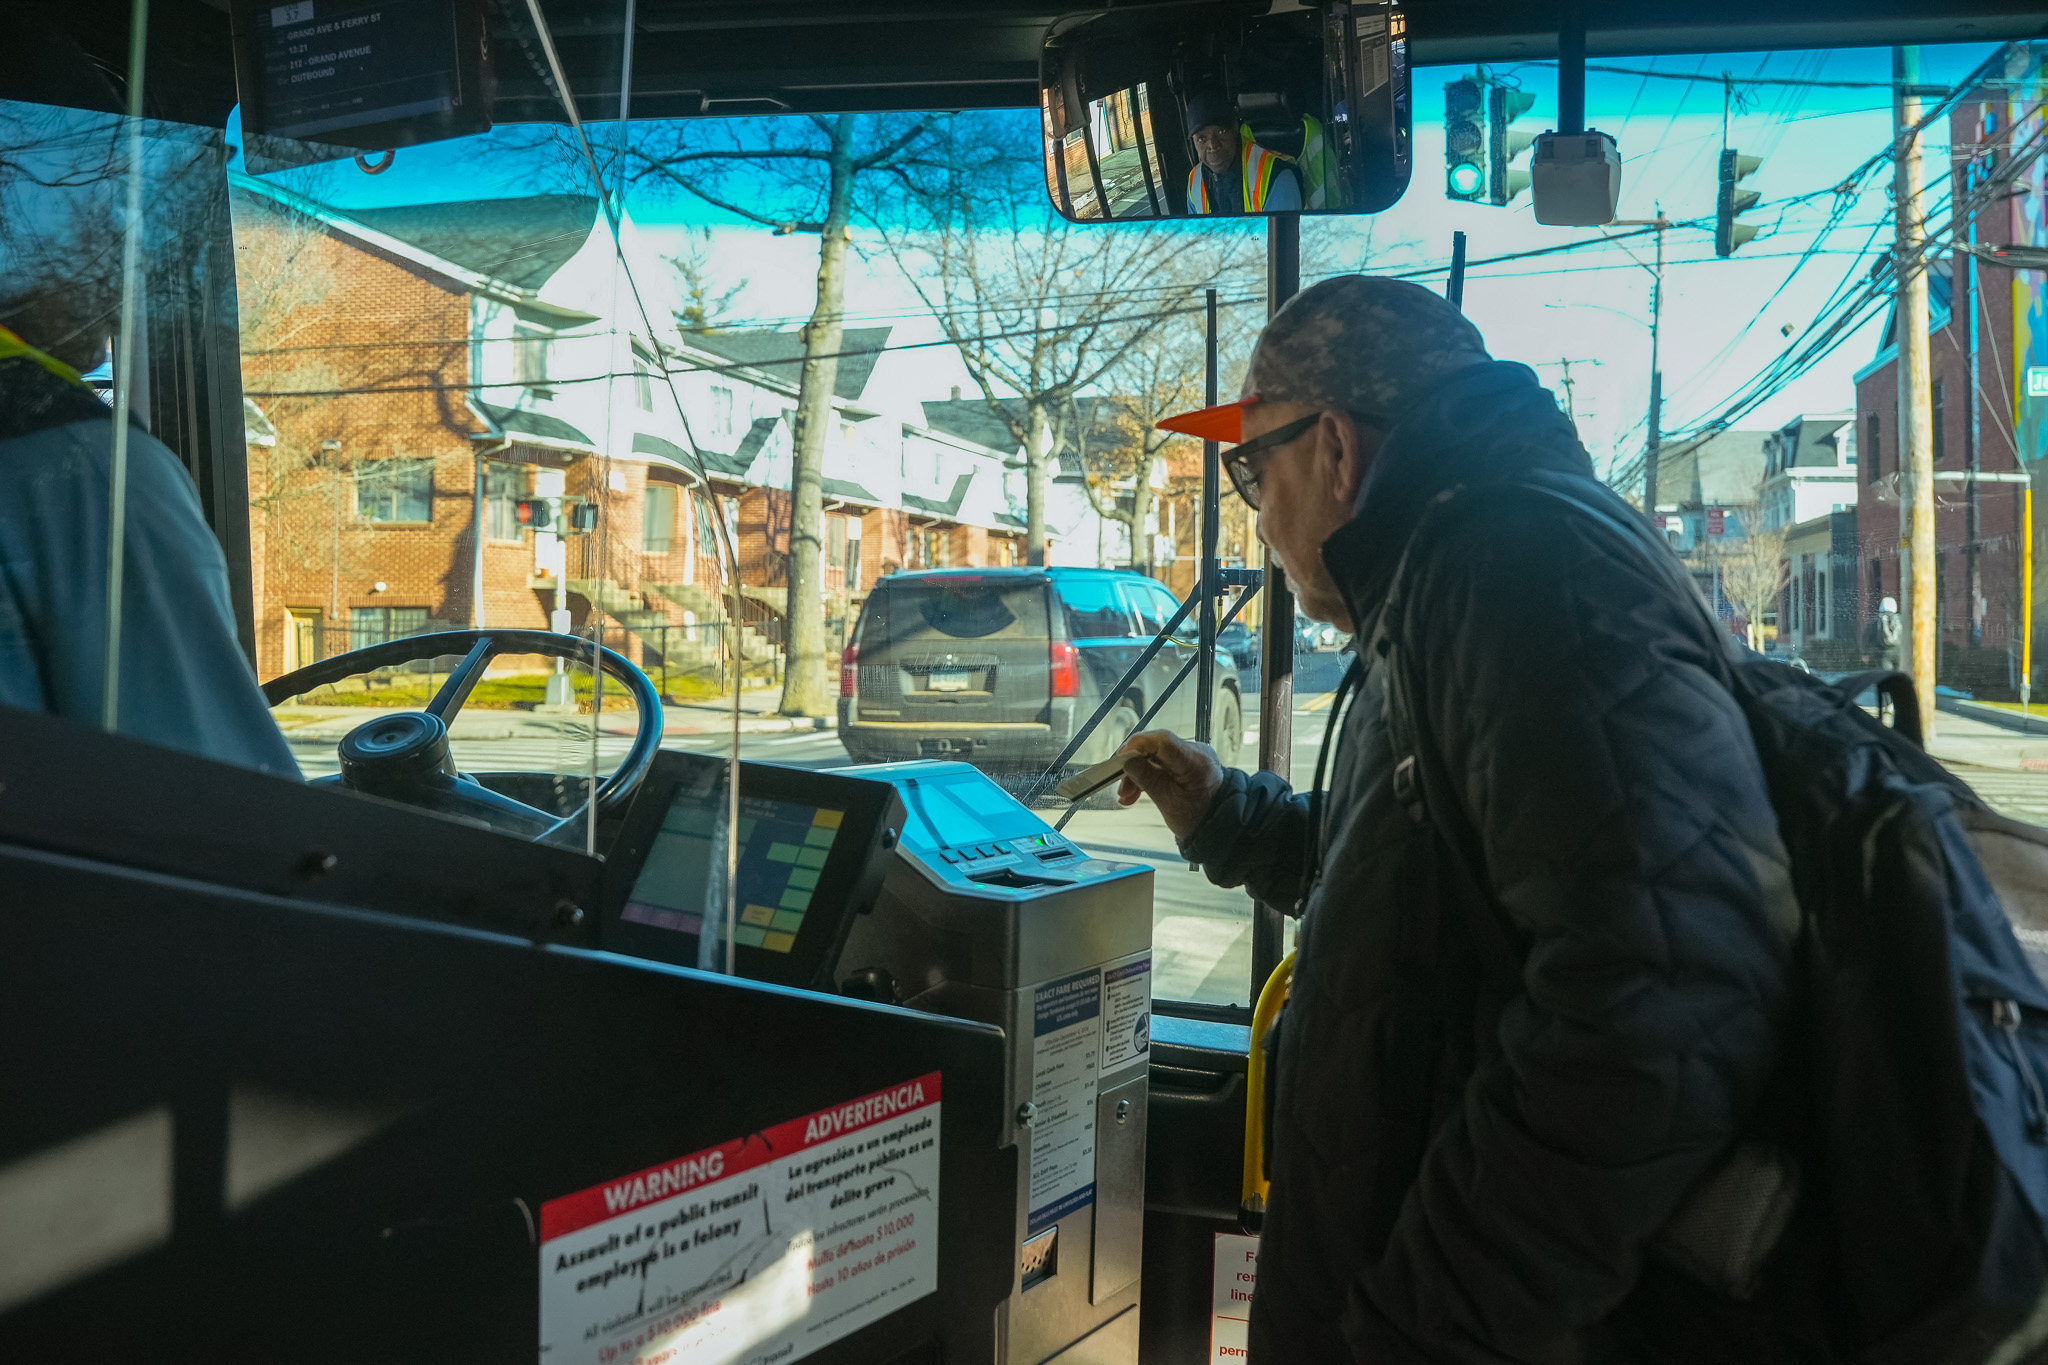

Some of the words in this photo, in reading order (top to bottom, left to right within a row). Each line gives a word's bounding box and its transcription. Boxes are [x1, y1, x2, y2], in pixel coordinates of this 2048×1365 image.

[287, 27, 315, 41] GRAND
[316, 23, 333, 34] AVE
[342, 16, 369, 29] FERRY
[370, 12, 381, 23] ST
[290, 59, 303, 70] 212
[308, 53, 336, 66] GRAND
[338, 46, 372, 60] AVENUE
[290, 67, 336, 83] OUTBOUND
[1036, 988, 1055, 1003] EXACT
[1056, 982, 1070, 996] FARE
[1072, 974, 1100, 990] REQUIRED
[804, 1081, 924, 1144] ADVERTENCIA
[785, 1182, 805, 1203] del
[806, 1163, 866, 1194] transporte
[868, 1146, 906, 1174] público
[908, 1144, 920, 1155] es
[921, 1136, 934, 1150] un
[788, 1165, 802, 1180] La
[805, 1148, 855, 1176] agresión
[857, 1143, 865, 1154] a
[867, 1136, 880, 1152] un
[883, 1116, 932, 1148] empleado
[603, 1150, 725, 1214] WARNING
[830, 1188, 862, 1210] delito
[864, 1175, 895, 1198] grave
[555, 1234, 620, 1272] Assault
[624, 1224, 641, 1244] of
[645, 1226, 655, 1237] a
[660, 1204, 706, 1239] public
[710, 1182, 760, 1216] transit
[664, 1242, 676, 1258] is
[680, 1239, 690, 1252] a
[690, 1215, 741, 1250] felony
[807, 1249, 834, 1271] Multa
[849, 1228, 875, 1253] hasta
[877, 1212, 915, 1242] $10,000
[828, 1214, 865, 1238] infractores
[807, 1276, 834, 1297] Hasta
[837, 1266, 849, 1282] 10
[851, 1256, 873, 1276] años
[874, 1250, 886, 1266] de
[887, 1238, 916, 1262] prisión
[583, 1323, 600, 1340] All
[648, 1297, 662, 1314] will
[667, 1293, 679, 1304] be
[598, 1347, 618, 1364] Up
[620, 1339, 633, 1353] to
[635, 1335, 645, 1346] a
[648, 1306, 698, 1342] $10,000
[700, 1299, 722, 1316] fine
